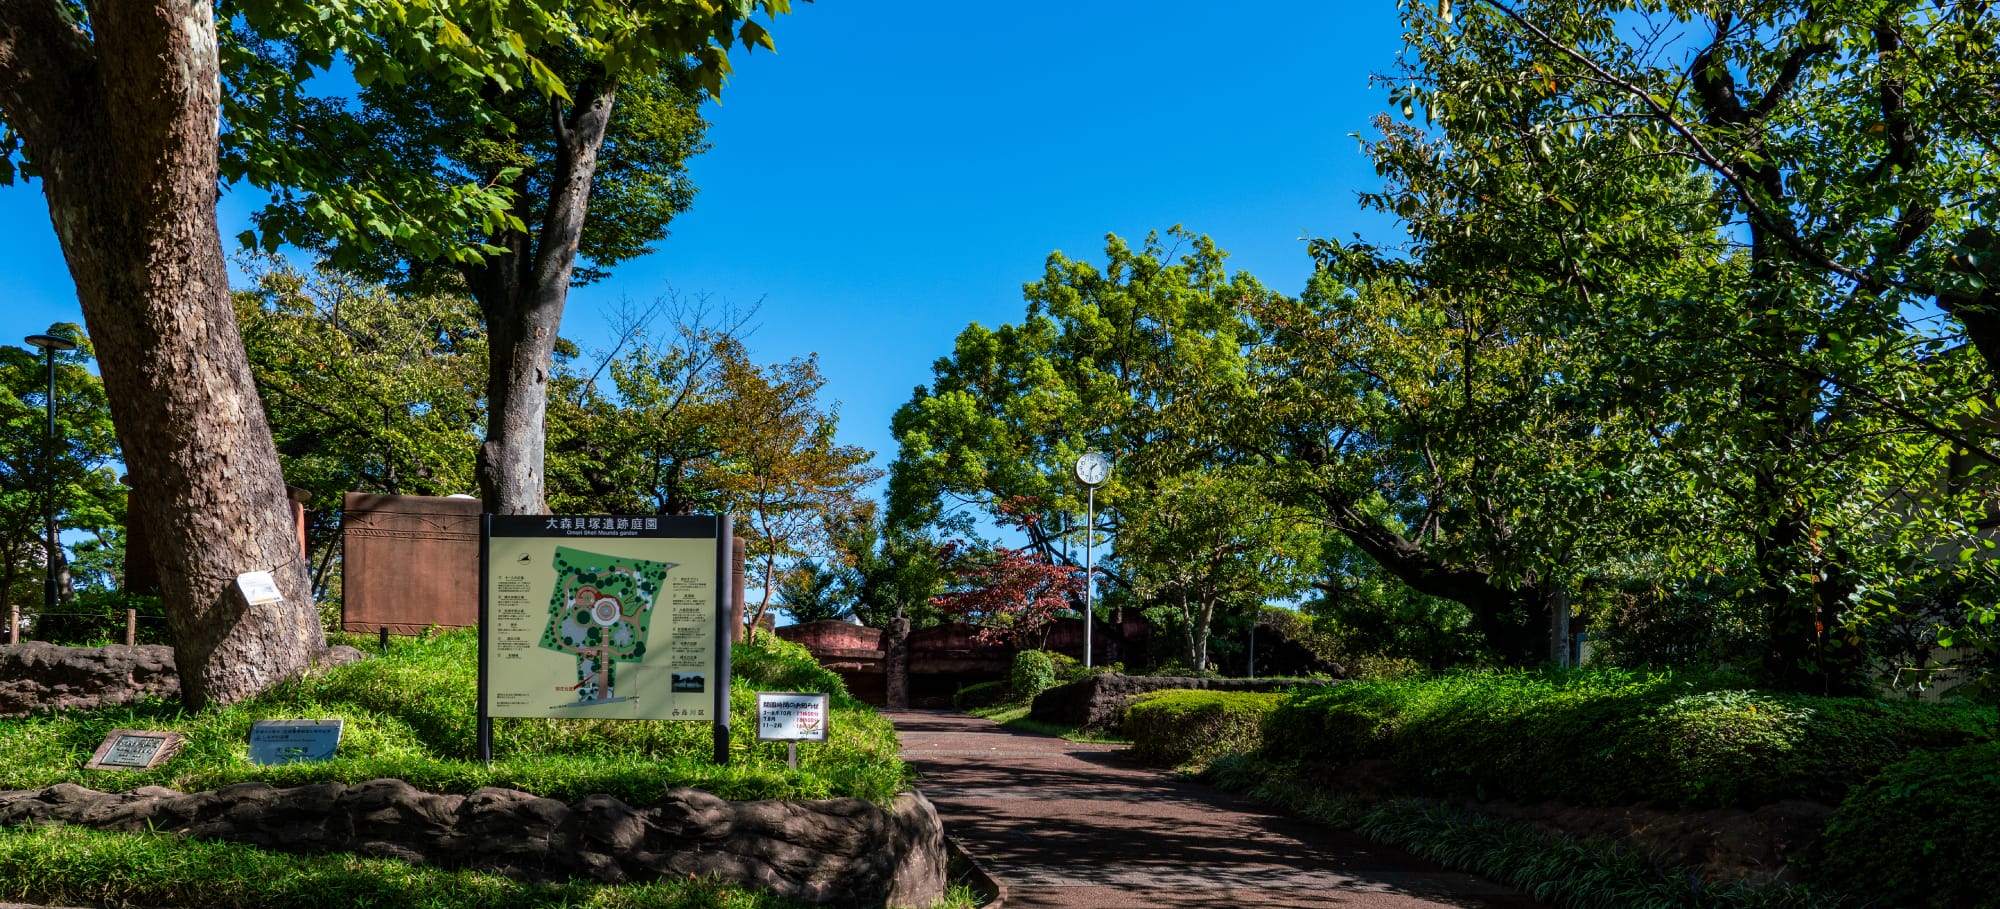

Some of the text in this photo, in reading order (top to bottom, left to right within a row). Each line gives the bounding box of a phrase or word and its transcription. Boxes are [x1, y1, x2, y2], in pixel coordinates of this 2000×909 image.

[546, 518, 658, 530] 大森貝塚遺跡庭園
